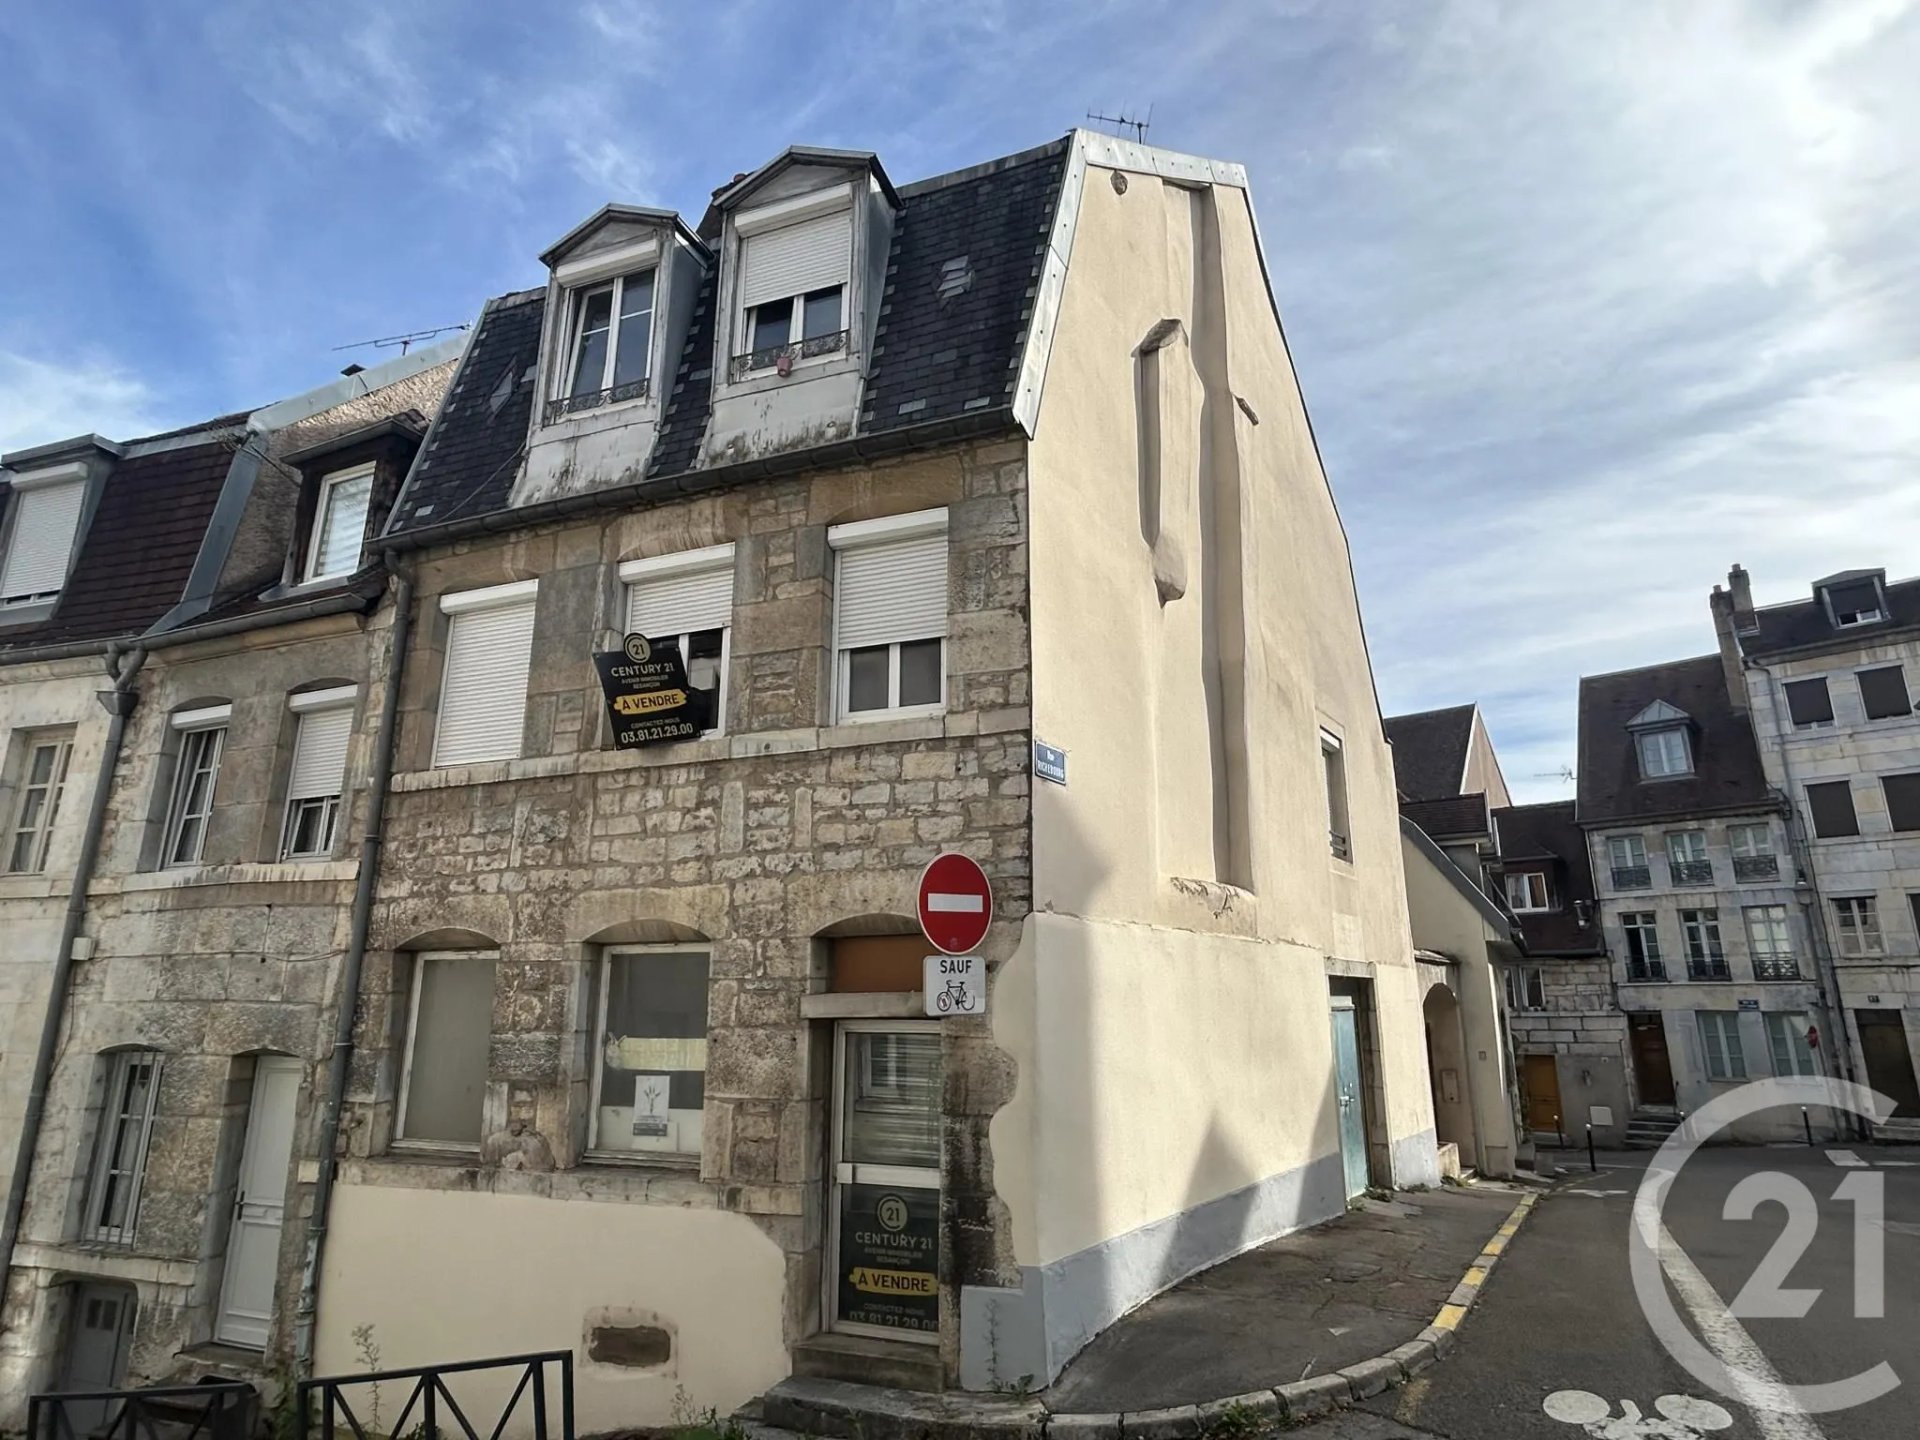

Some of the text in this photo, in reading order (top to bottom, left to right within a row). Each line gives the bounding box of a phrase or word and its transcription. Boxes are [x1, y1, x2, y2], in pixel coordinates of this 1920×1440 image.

[632, 644, 645, 655] 21
[611, 663, 674, 677] CENTURY 21
[622, 694, 680, 710] À VENDRE
[621, 722, 694, 743] 03.81.21.29.00
[940, 960, 972, 974] SAUF
[886, 1207, 899, 1222] 21
[855, 1232, 933, 1250] CENTURY 21
[858, 1269, 931, 1292] À VENDRE
